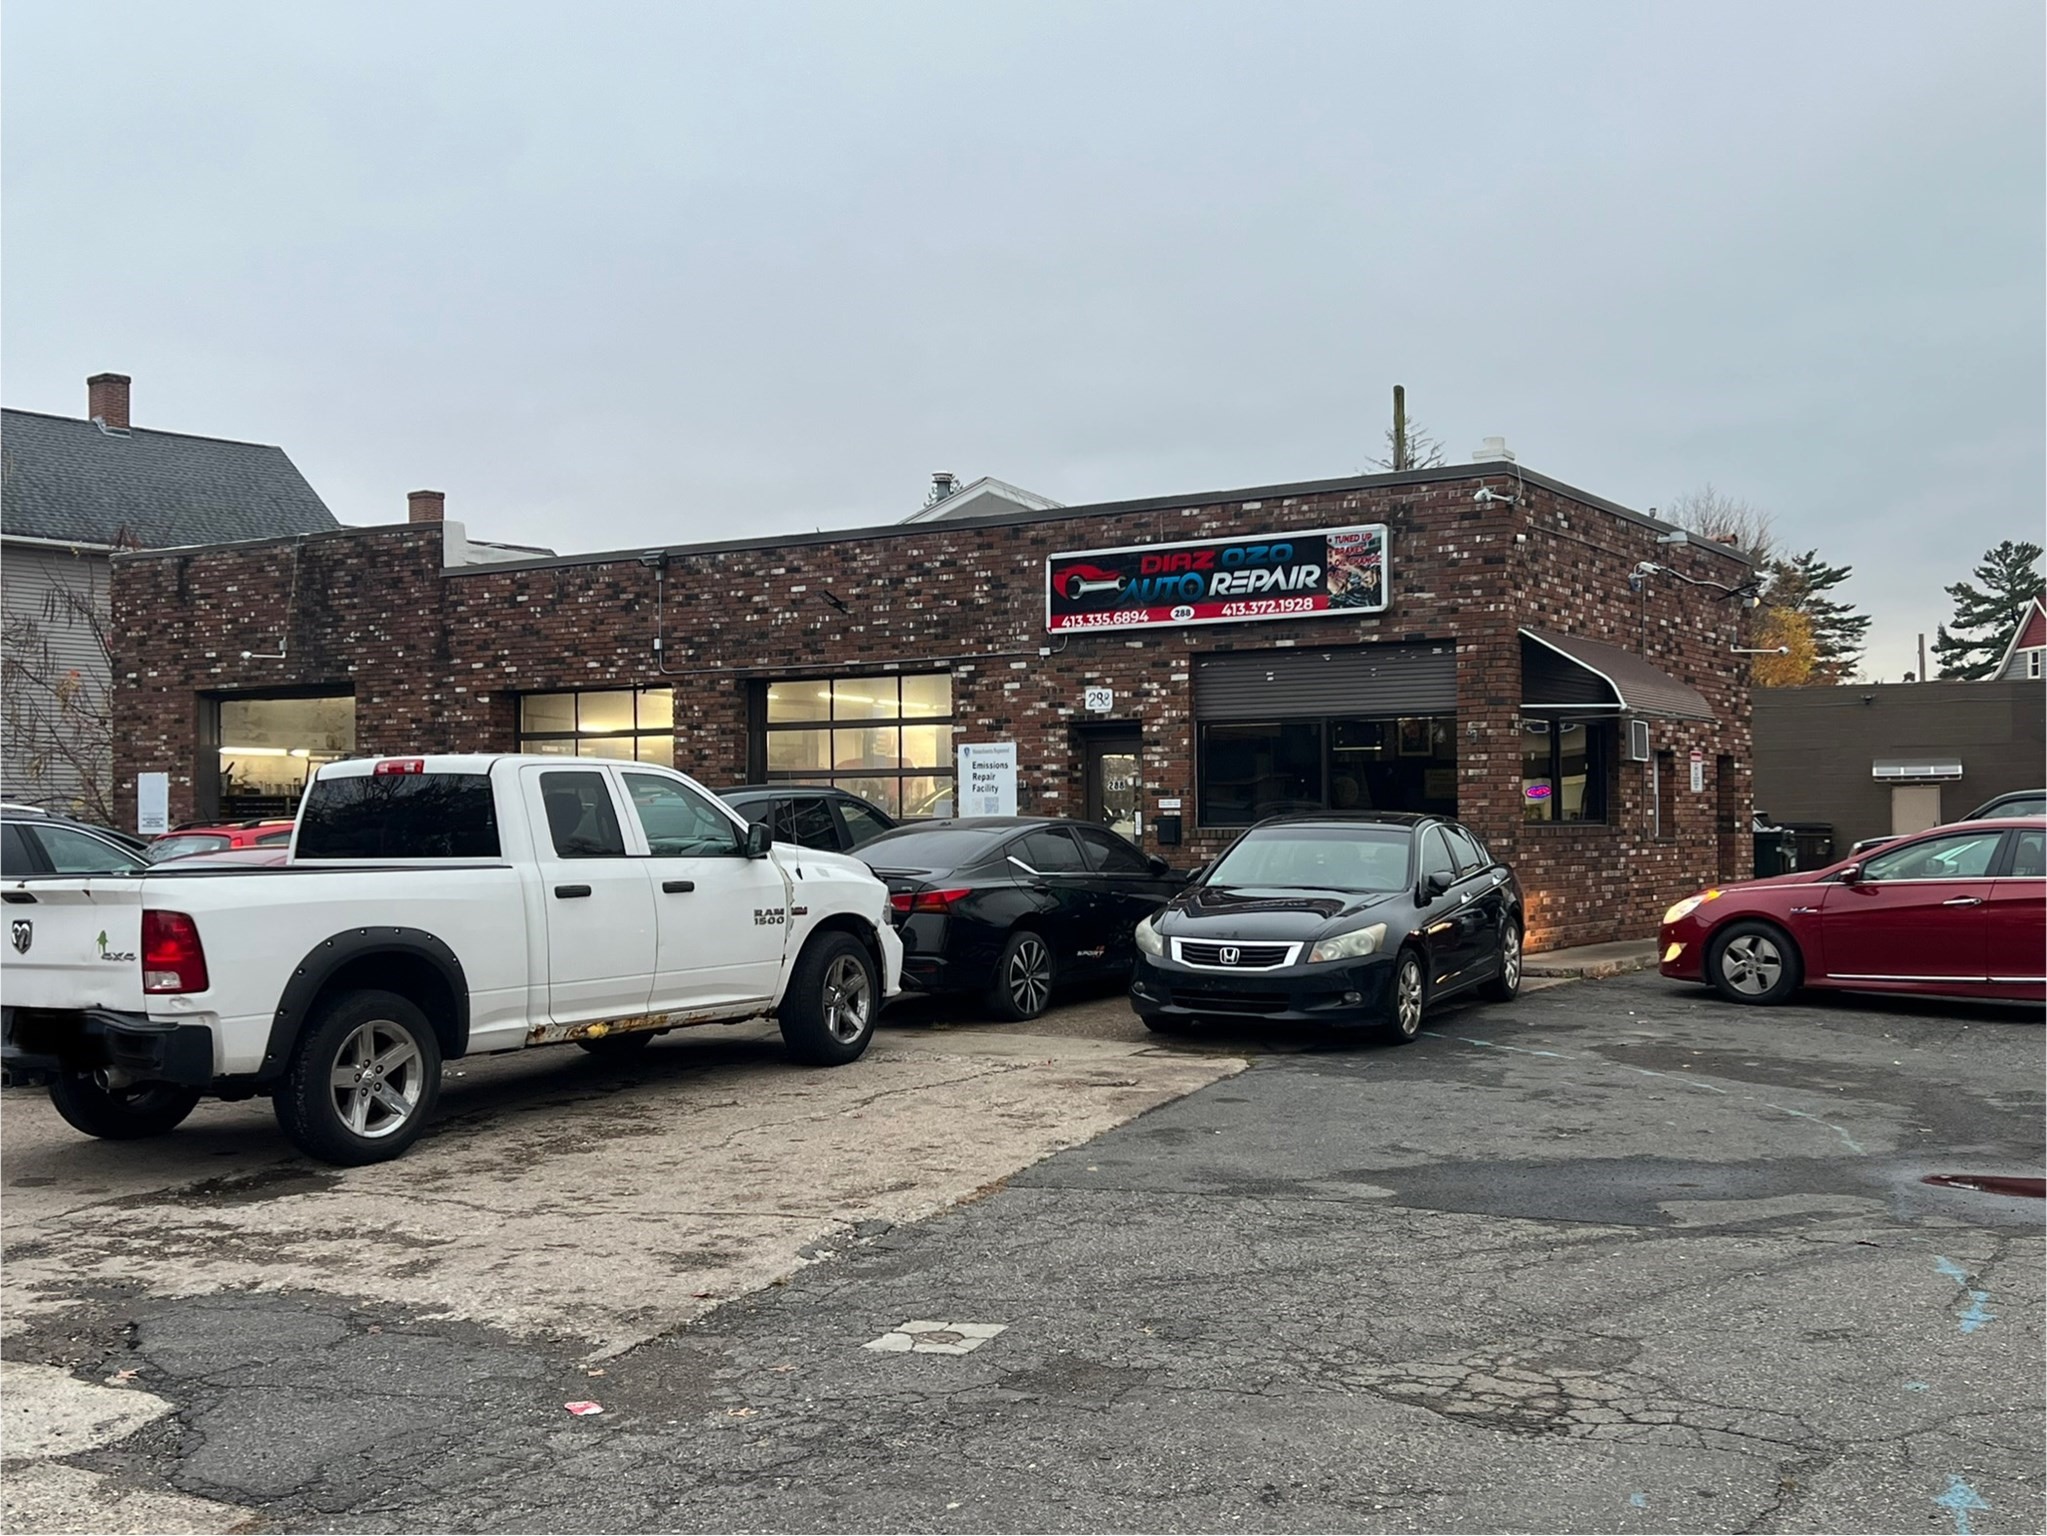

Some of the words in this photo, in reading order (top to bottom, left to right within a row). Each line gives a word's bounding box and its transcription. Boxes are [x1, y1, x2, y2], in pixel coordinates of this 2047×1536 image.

[1334, 534, 1360, 544] TUNED
[1362, 532, 1373, 541] UP
[1334, 546, 1366, 556] BRAKES
[1141, 550, 1216, 575] DIAZ
[1221, 543, 1294, 567] OZO
[1118, 572, 1205, 602] AUTO
[1208, 564, 1322, 596] REPAIR
[1221, 597, 1314, 616] 413.372.1928
[1174, 607, 1192, 618] 288
[1061, 609, 1150, 628] 413.335.6894
[972, 761, 1009, 770] Emissions
[972, 772, 996, 782] Repair
[972, 784, 999, 795] Facility
[1107, 780, 1126, 791] 288
[754, 908, 785, 917] RAM
[754, 916, 785, 926] 1500
